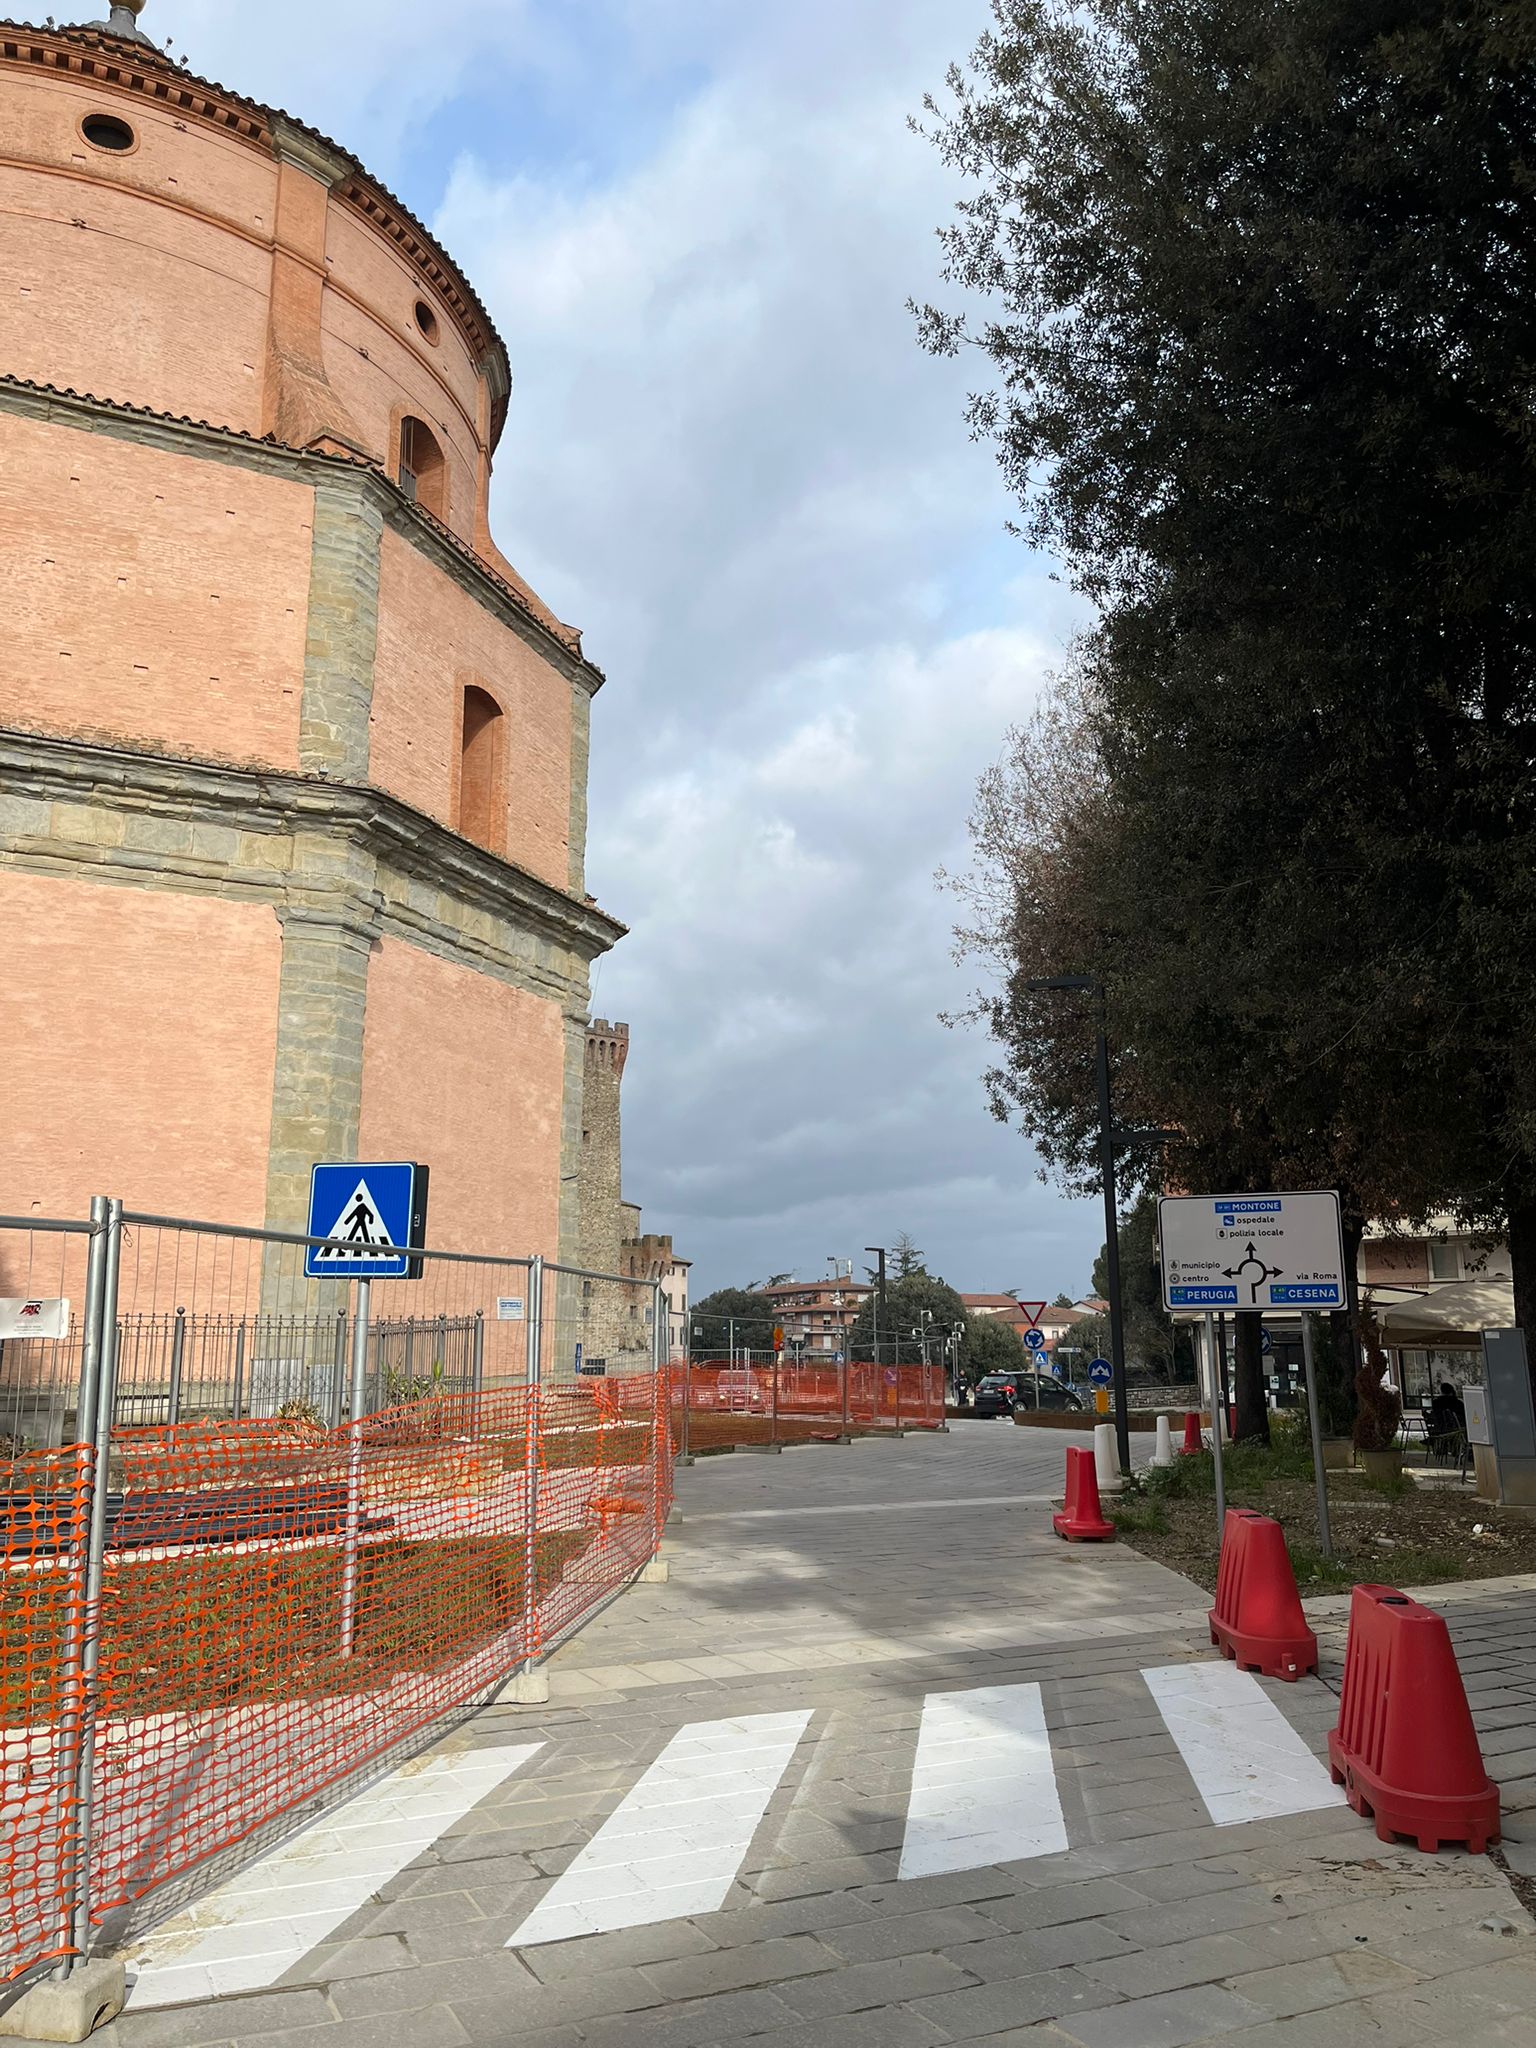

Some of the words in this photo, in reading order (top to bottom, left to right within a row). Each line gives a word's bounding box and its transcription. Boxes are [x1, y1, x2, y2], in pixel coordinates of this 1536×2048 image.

[1232, 1202, 1279, 1211] MONTONE
[1236, 1216, 1275, 1224] ospedale
[1230, 1230, 1255, 1238] polizia
[1258, 1229, 1284, 1237] locale
[1181, 1261, 1221, 1270] municipio
[1296, 1272, 1309, 1280] via
[1313, 1272, 1337, 1280] Roma
[1187, 1290, 1235, 1300] PERUGIA
[1288, 1288, 1336, 1298] CESENA
